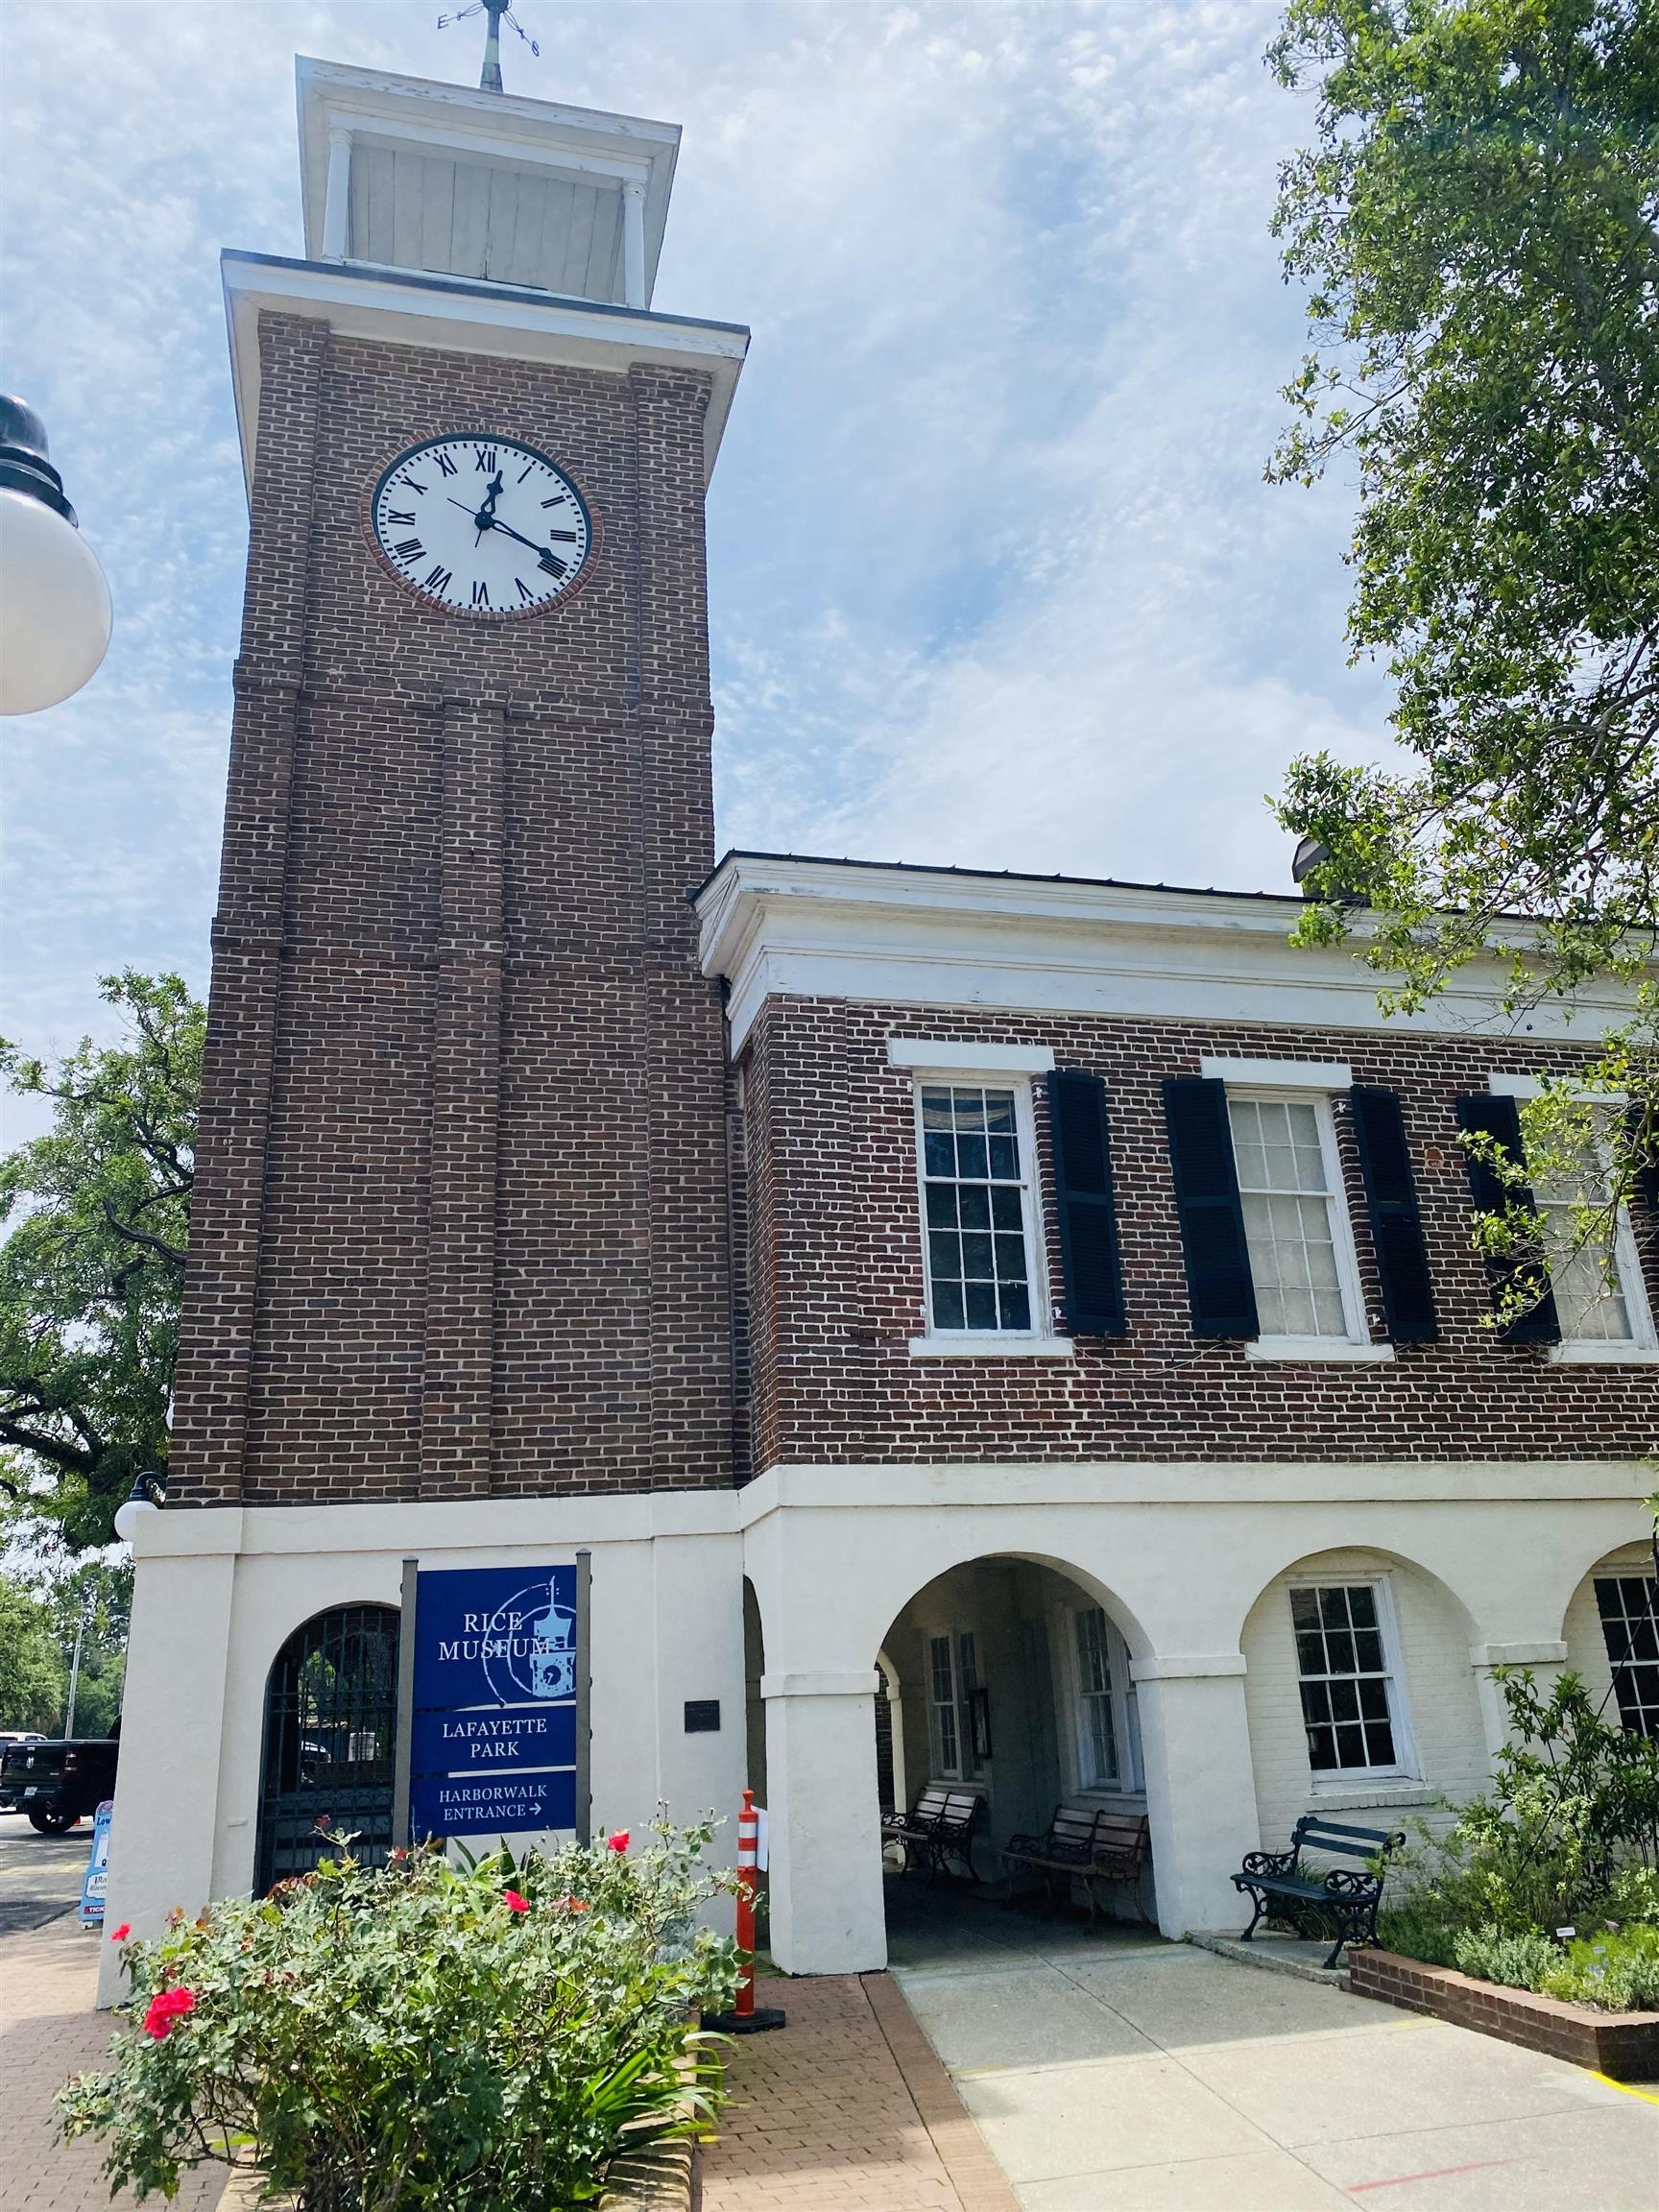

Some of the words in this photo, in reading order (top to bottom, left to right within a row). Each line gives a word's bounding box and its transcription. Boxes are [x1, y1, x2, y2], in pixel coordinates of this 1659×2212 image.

[433, 452, 458, 477] XI
[475, 449, 495, 473] XII
[463, 1611, 523, 1633] RICE
[438, 1637, 550, 1661] MUSEUM
[443, 1719, 548, 1739] LAFAYETTE
[470, 1741, 520, 1759] PARK
[439, 1784, 548, 1804] HARBORWALK
[444, 1804, 526, 1821] ENTRANCE
